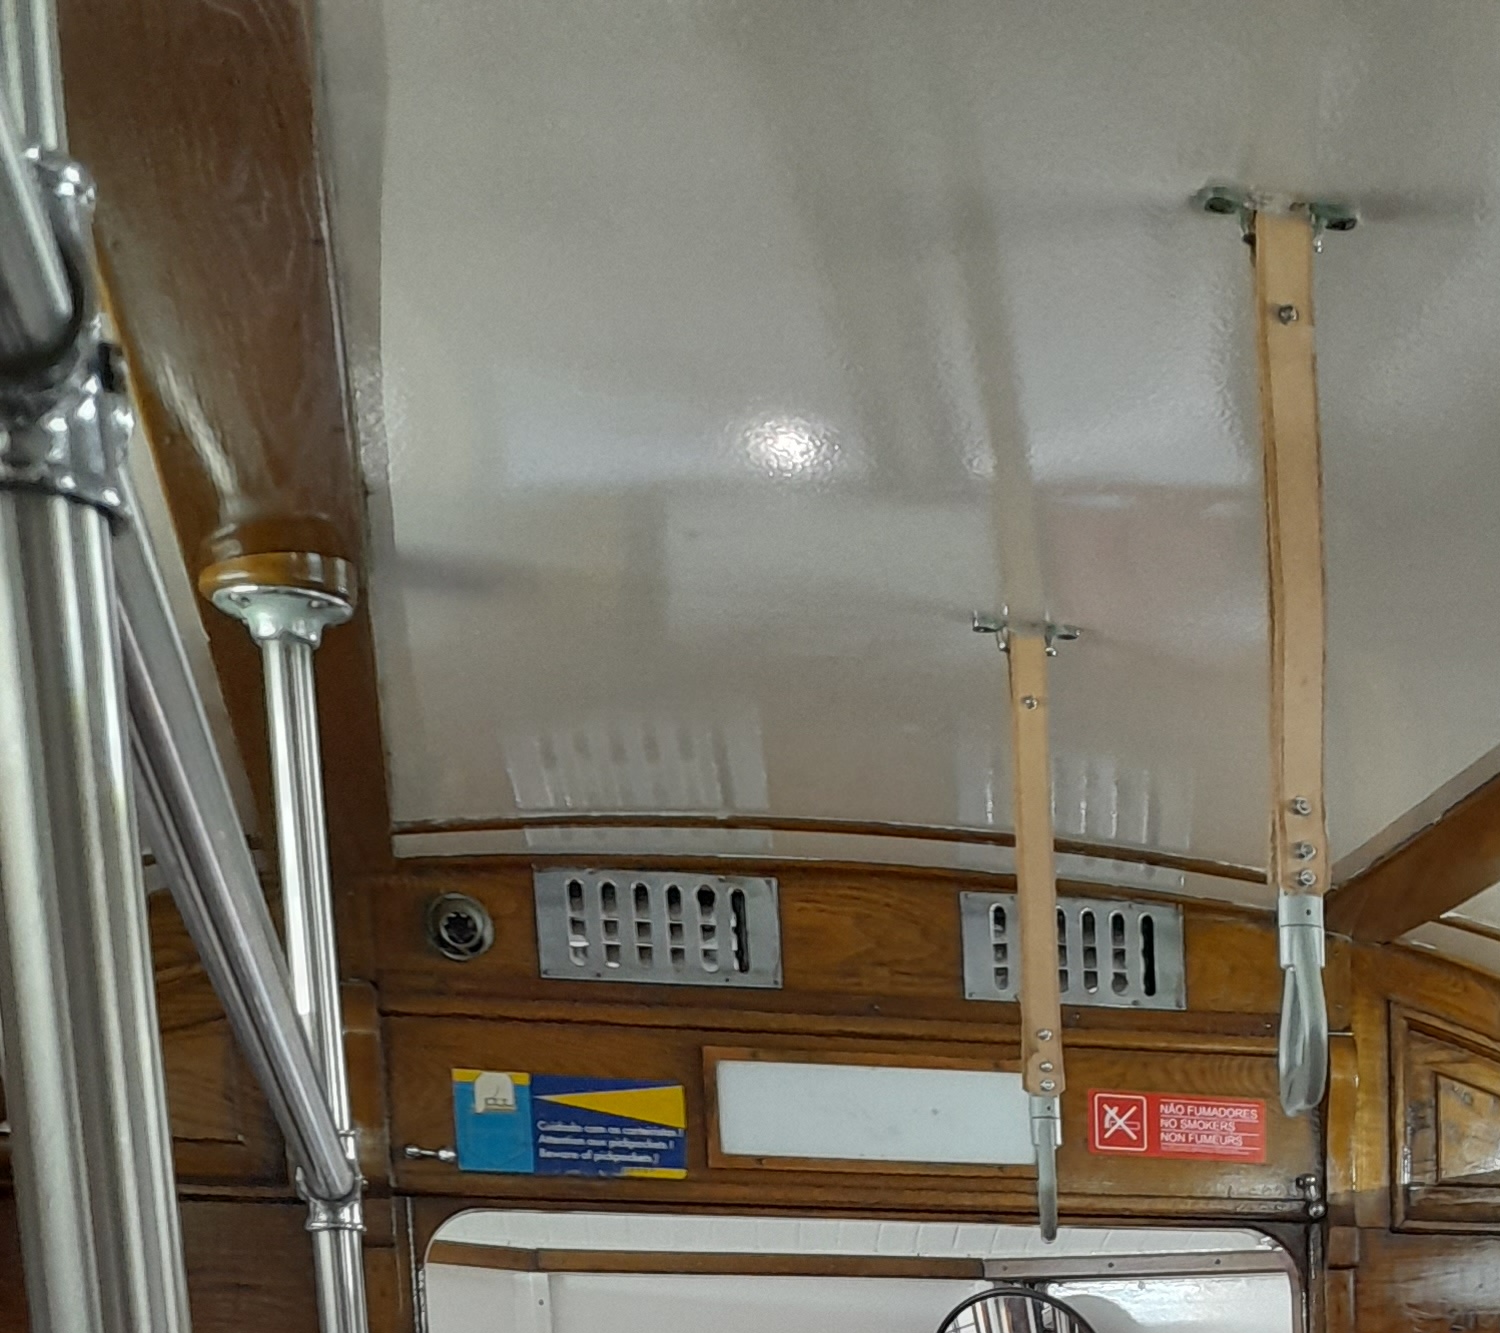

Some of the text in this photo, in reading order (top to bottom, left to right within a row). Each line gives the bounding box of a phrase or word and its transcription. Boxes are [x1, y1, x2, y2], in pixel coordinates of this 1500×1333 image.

[1160, 1103, 1258, 1119] NÃO FUMADORES
[1160, 1118, 1236, 1131] NO SMOKERS
[1160, 1132, 1243, 1146] NON FUMEURS
